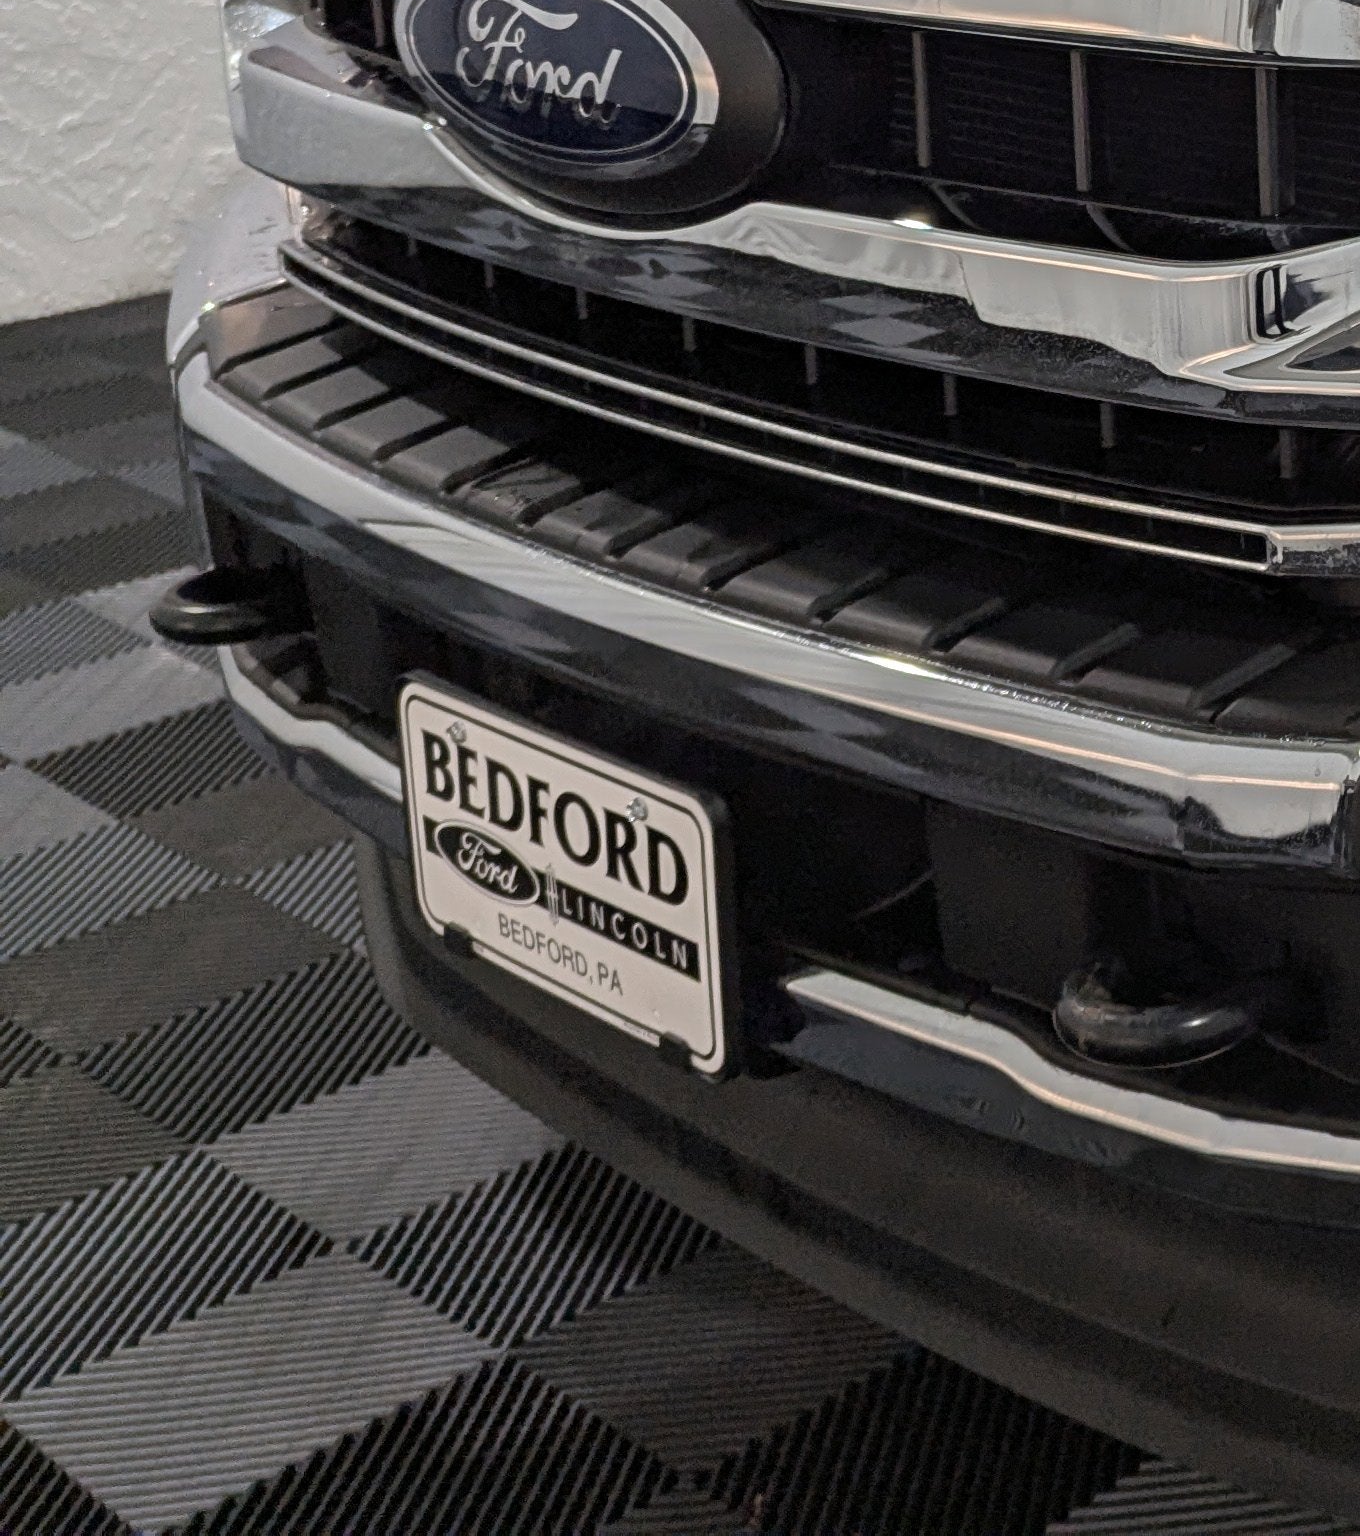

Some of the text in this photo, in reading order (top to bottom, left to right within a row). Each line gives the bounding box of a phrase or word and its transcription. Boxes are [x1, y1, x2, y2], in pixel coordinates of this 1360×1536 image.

[421, 729, 690, 907] BEDFORD
[457, 833, 688, 970] Ford LINCOLN
[497, 912, 624, 996] BEDFORD, PA
